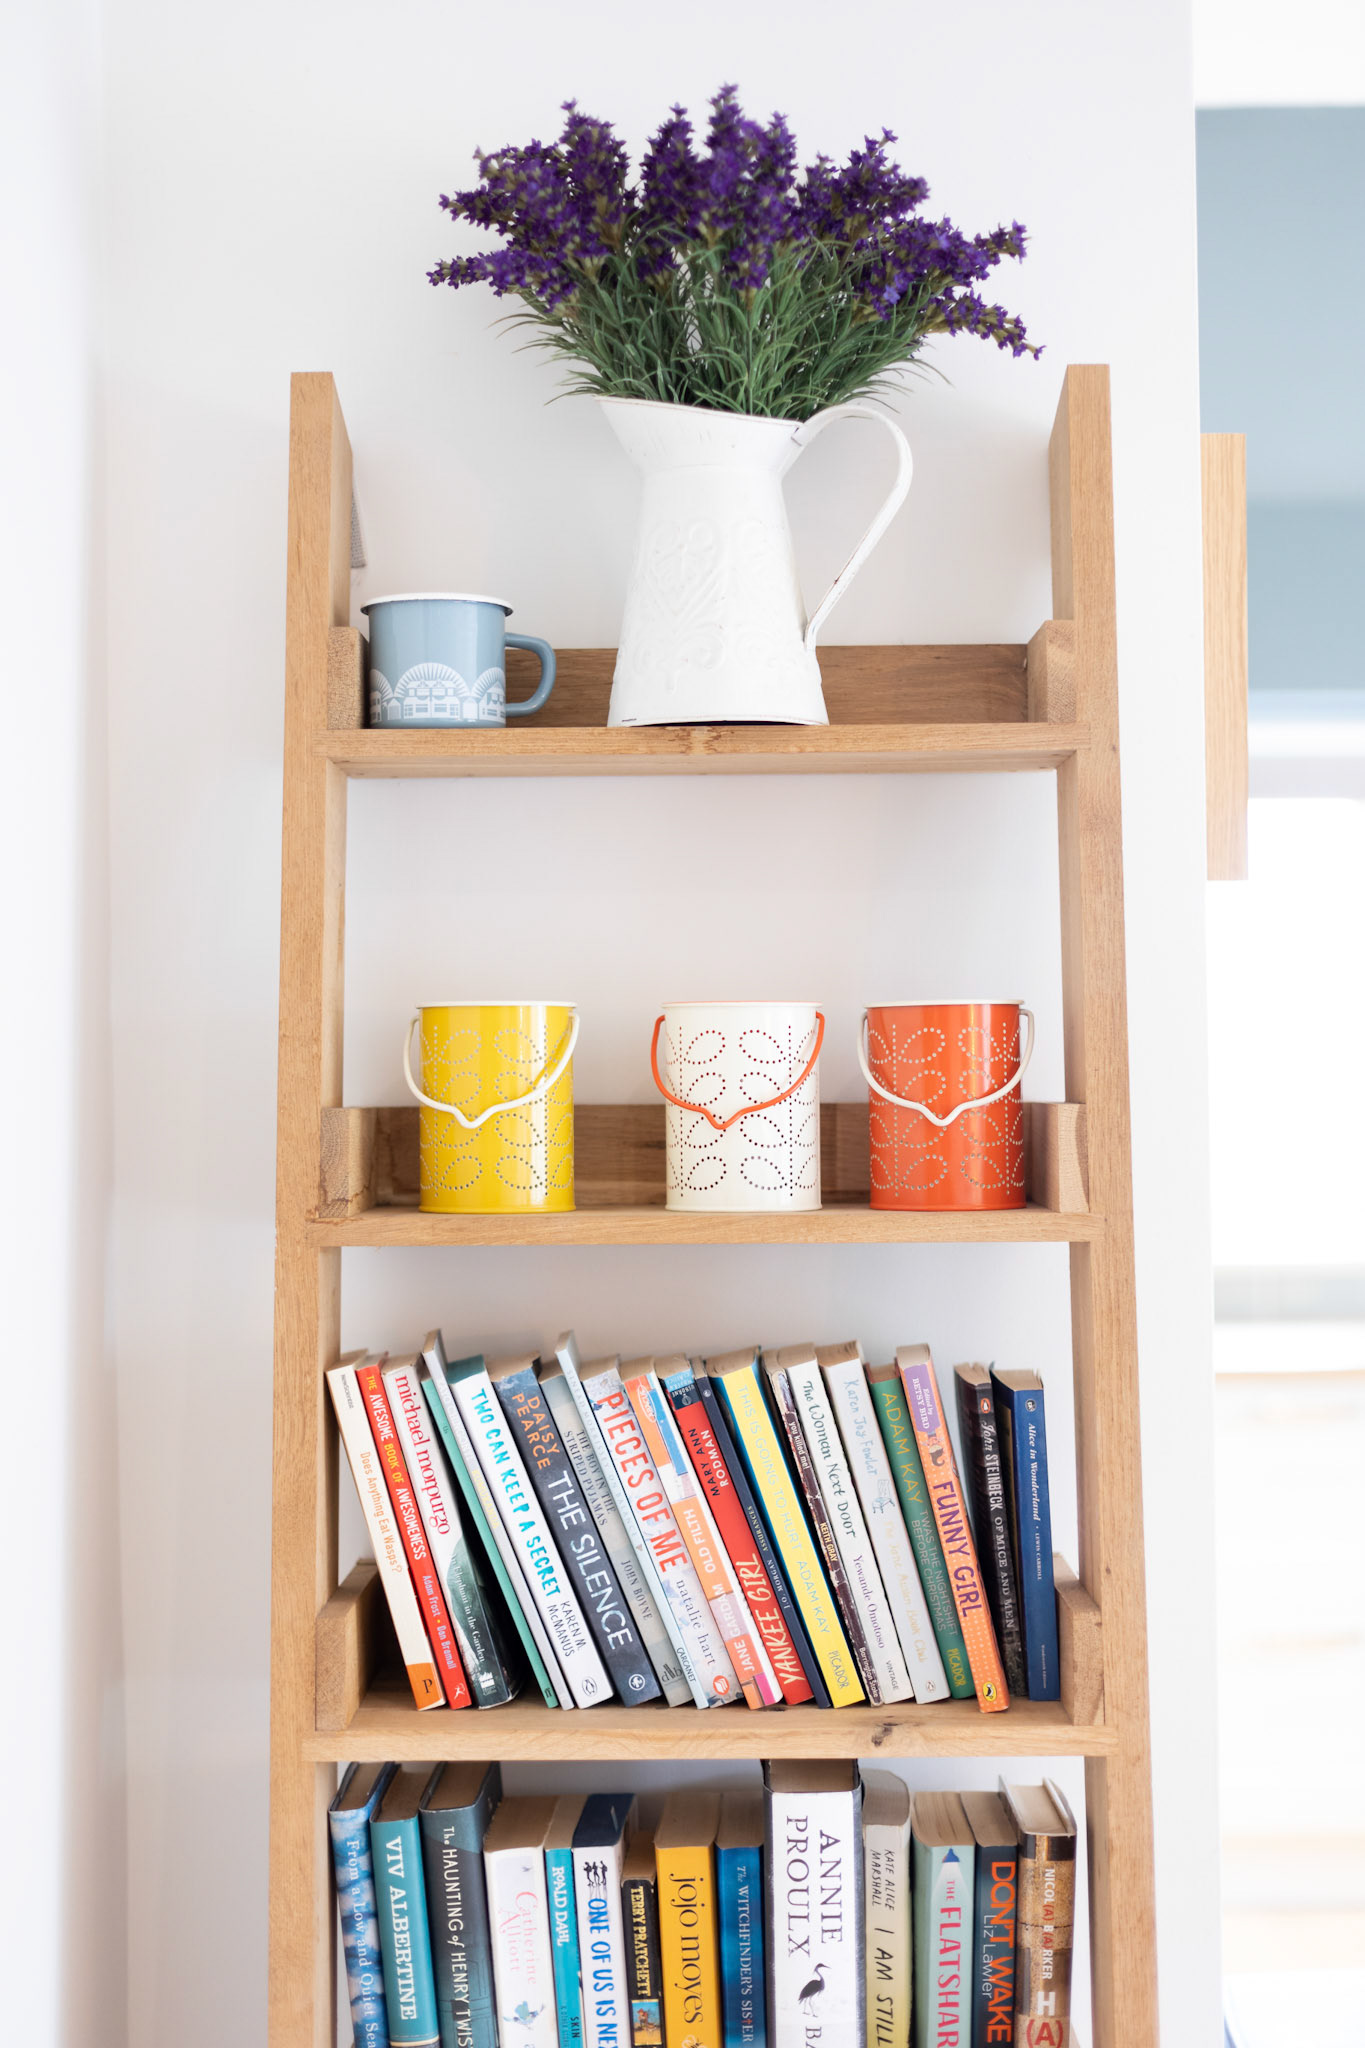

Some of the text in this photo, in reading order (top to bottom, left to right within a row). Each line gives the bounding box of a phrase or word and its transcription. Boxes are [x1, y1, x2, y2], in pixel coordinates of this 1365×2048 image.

[512, 1393, 551, 1470] PEARCE
[527, 1396, 560, 1454] DAISY
[844, 1379, 878, 1476] Karen Joy Fowler
[912, 1378, 930, 1429] BETSY BIRD
[923, 1388, 932, 1407] Edited
[366, 1375, 427, 1561] THE AWESOME BOOK OF AWESOMENESS
[395, 1374, 450, 1535] michael morpurgo
[564, 1430, 587, 1476] STRIPED
[583, 1478, 608, 1526] PYJAMAS
[576, 1429, 617, 1515] THE BOY IN THE
[597, 1391, 688, 1573] PIECES OF ME
[688, 1428, 720, 1496] MARY ANN
[701, 1429, 729, 1488] RODMAN
[738, 1384, 802, 1551] THIS IS GOING TO HURT
[788, 1421, 810, 1469] you killed me!
[803, 1380, 856, 1538] The Woman Next Door
[882, 1393, 923, 1504] ADAM KAY
[1028, 1422, 1041, 1522] Alice in Wonderland
[360, 1451, 403, 1573] Does Anything Eat Wasps?
[471, 1388, 561, 1597] TWO CAN KEEP A SECRET
[747, 1505, 768, 1552] ASSURANCES
[981, 1420, 1015, 1629] John STEINBECK OF MICE AND MEN
[547, 1470, 633, 1650] THE SILENCE
[683, 1508, 716, 1574] OLD FILTH
[767, 1558, 783, 1592] MORGAN
[820, 1522, 839, 1562] KEITH GRAY
[911, 1520, 947, 1632] BEFORE CHRISTMAS
[933, 1481, 982, 1618] FUNNY GIRL
[423, 1575, 456, 1669] Adam Frost Dan Bramall
[455, 1566, 486, 1663] Elephant in the Garden
[546, 1604, 575, 1657] McMANUS
[560, 1601, 581, 1636] KAREN
[620, 1559, 653, 1620] JOHN BOYNE
[676, 1579, 717, 1665] natalie hart
[712, 1583, 755, 1671] JANE GARDAM
[735, 1552, 806, 1685] YANKEE GIRL
[796, 1560, 831, 1633] ADAM KAY
[853, 1554, 885, 1649] Yewande Omotoso
[928, 1545, 941, 1568] THE
[935, 1569, 958, 1636] NIGHTSHIFT
[422, 1679, 433, 1694] P
[828, 1650, 850, 1690] PICADOR
[859, 1647, 879, 1698] Barrington Stoke
[885, 1659, 899, 1690] VINTAGE
[948, 1648, 967, 1688] PICADOR
[346, 1839, 360, 1881] From
[351, 1886, 361, 1896] a
[736, 1865, 747, 1883] The
[786, 1815, 811, 1958] PROULX
[819, 1829, 843, 1944] ANNIE
[870, 1849, 882, 1907] MARSHALL
[884, 1848, 895, 1912] KATE ALICE
[946, 1880, 955, 1902] THE
[353, 1901, 366, 1933] Low
[386, 1835, 417, 2020] VIV ALBERTINE
[443, 1826, 470, 2004] The HAUNTING of HENRY
[498, 1905, 521, 1972] Alliott
[515, 1891, 538, 1985] Catherine
[552, 1866, 570, 1946] ROALD DAHL
[630, 1886, 651, 1997] TERRY PRATCHETT
[670, 1873, 705, 2024] jojo moyes
[737, 1885, 752, 1996] WITCHFINDER'S
[1041, 1868, 1056, 1980] NICOL(A) B(A)RKER
[357, 1937, 372, 1968] and
[359, 1972, 377, 2017] Quiet
[588, 1898, 617, 2017] ONE OF US IS
[873, 1927, 895, 2047] I AM STILL
[982, 1915, 997, 1999] Liz Lawler
[987, 1861, 1016, 2043] DON'T WAKE
[570, 2016, 581, 2039] SKIN
